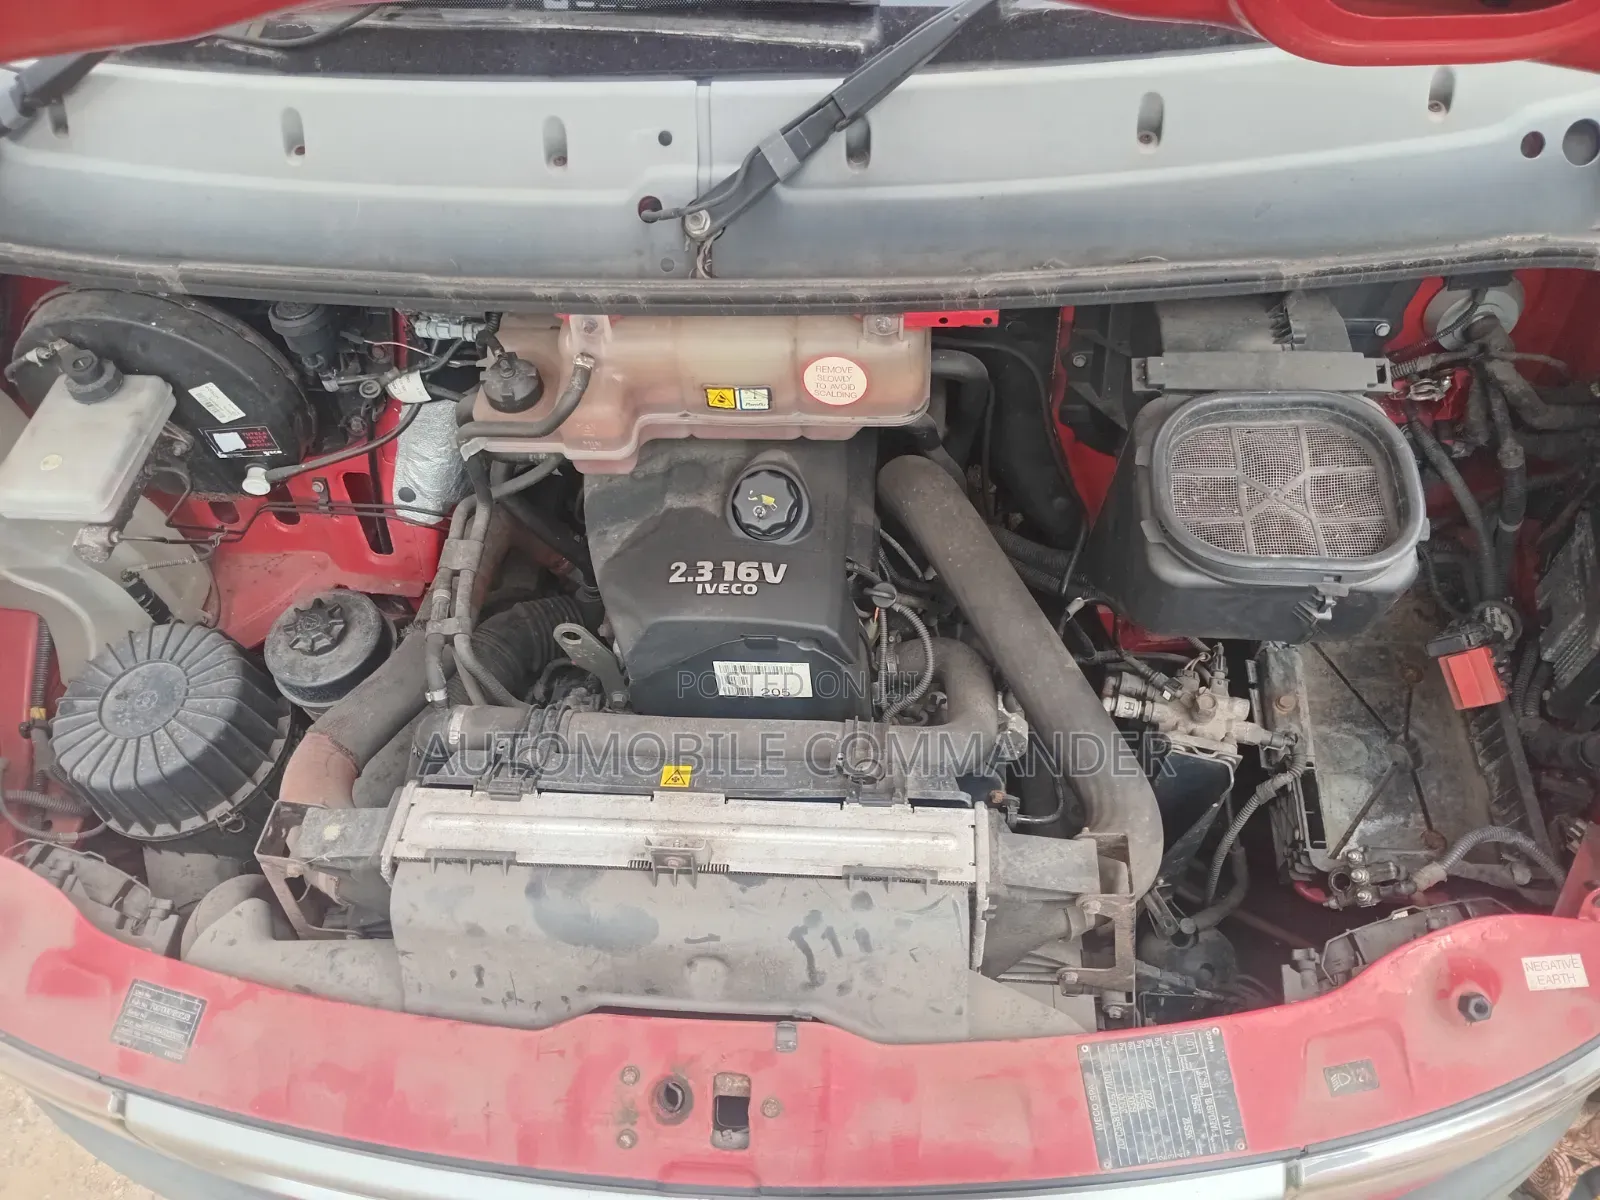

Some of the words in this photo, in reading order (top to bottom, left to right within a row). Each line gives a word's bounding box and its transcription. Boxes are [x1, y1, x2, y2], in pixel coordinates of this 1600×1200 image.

[816, 366, 853, 374] REMOVE
[816, 374, 852, 382] SLOWLY
[816, 382, 826, 390] TO
[830, 383, 856, 391] AVOID
[814, 390, 857, 399] SCALDING
[668, 561, 714, 583] 2.3
[722, 561, 788, 584] 16V
[696, 584, 758, 595] IVECO
[761, 688, 790, 696] 205
[1525, 959, 1580, 972] NEGATIVE
[1537, 972, 1576, 985] EARTH
[1204, 1030, 1215, 1053] IVECO
[1087, 1084, 1097, 1101] SPA
[1092, 1104, 1104, 1131] IVECO
[1221, 1114, 1233, 1136] ITALY
